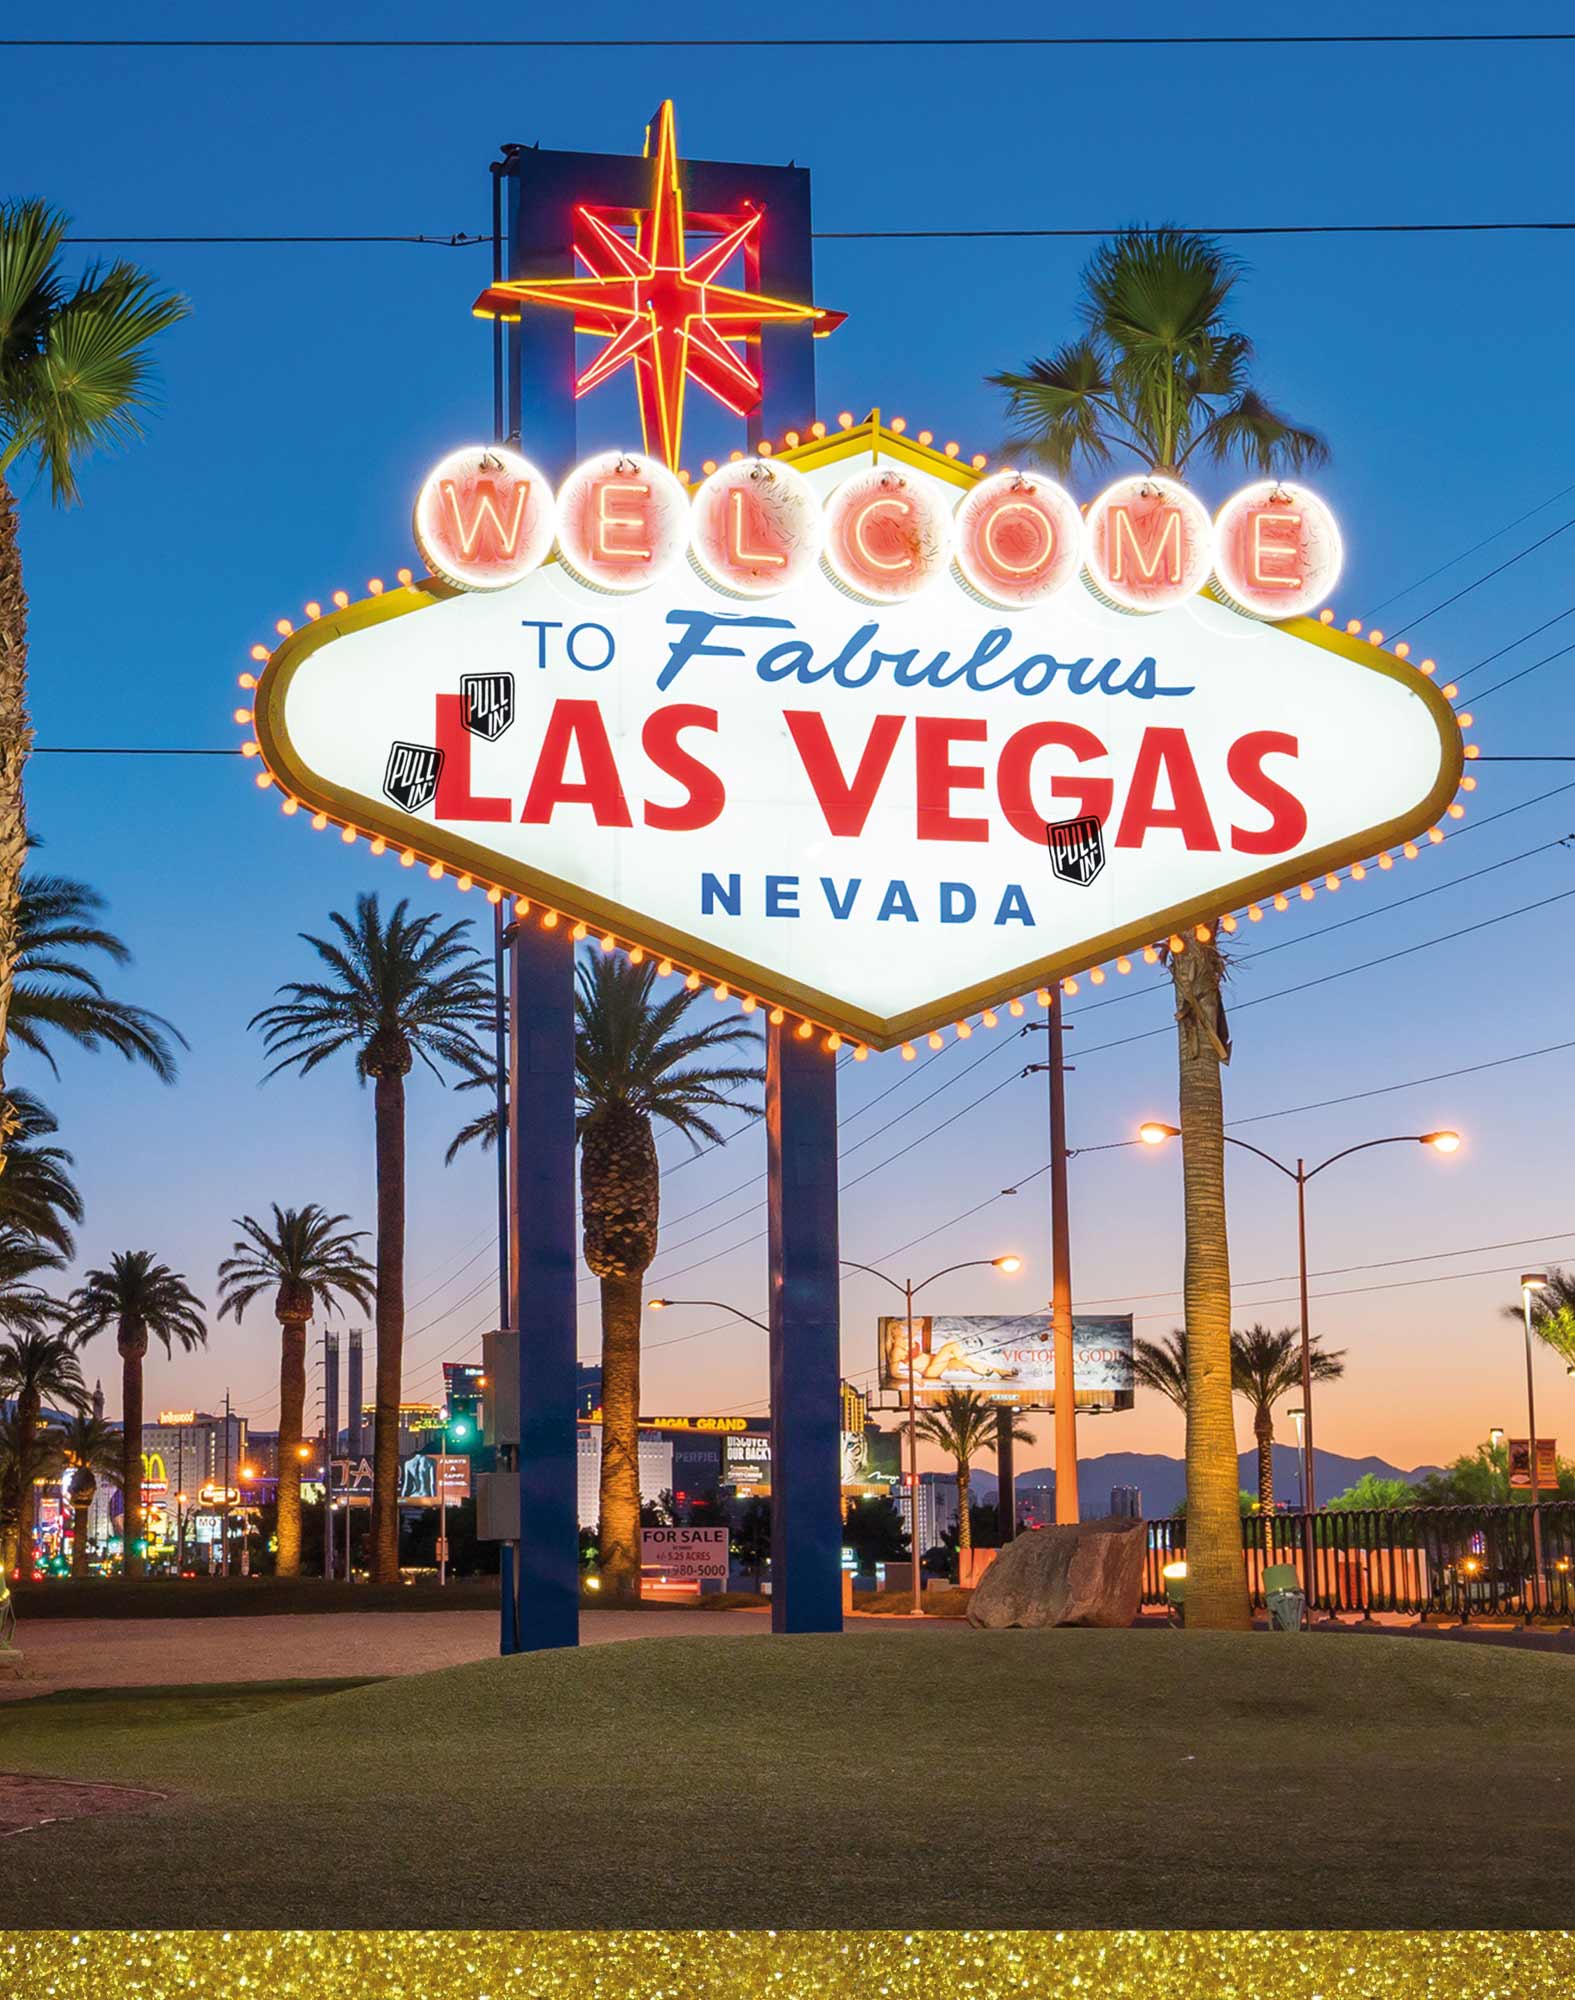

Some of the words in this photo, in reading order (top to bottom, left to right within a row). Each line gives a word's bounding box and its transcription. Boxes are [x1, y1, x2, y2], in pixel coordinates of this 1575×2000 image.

[438, 478, 1304, 593] WELCOME
[521, 619, 616, 672] TO
[655, 608, 1197, 700] Fabulous
[434, 692, 727, 832] LAS
[781, 708, 1309, 857] VEGAS
[701, 872, 1037, 928] NEVADA
[695, 1417, 748, 1432] GRAND
[727, 1447, 744, 1460] OUR
[643, 1530, 677, 1543] FOR
[681, 1530, 724, 1543] SALE
[686, 1551, 712, 1561] ACRES
